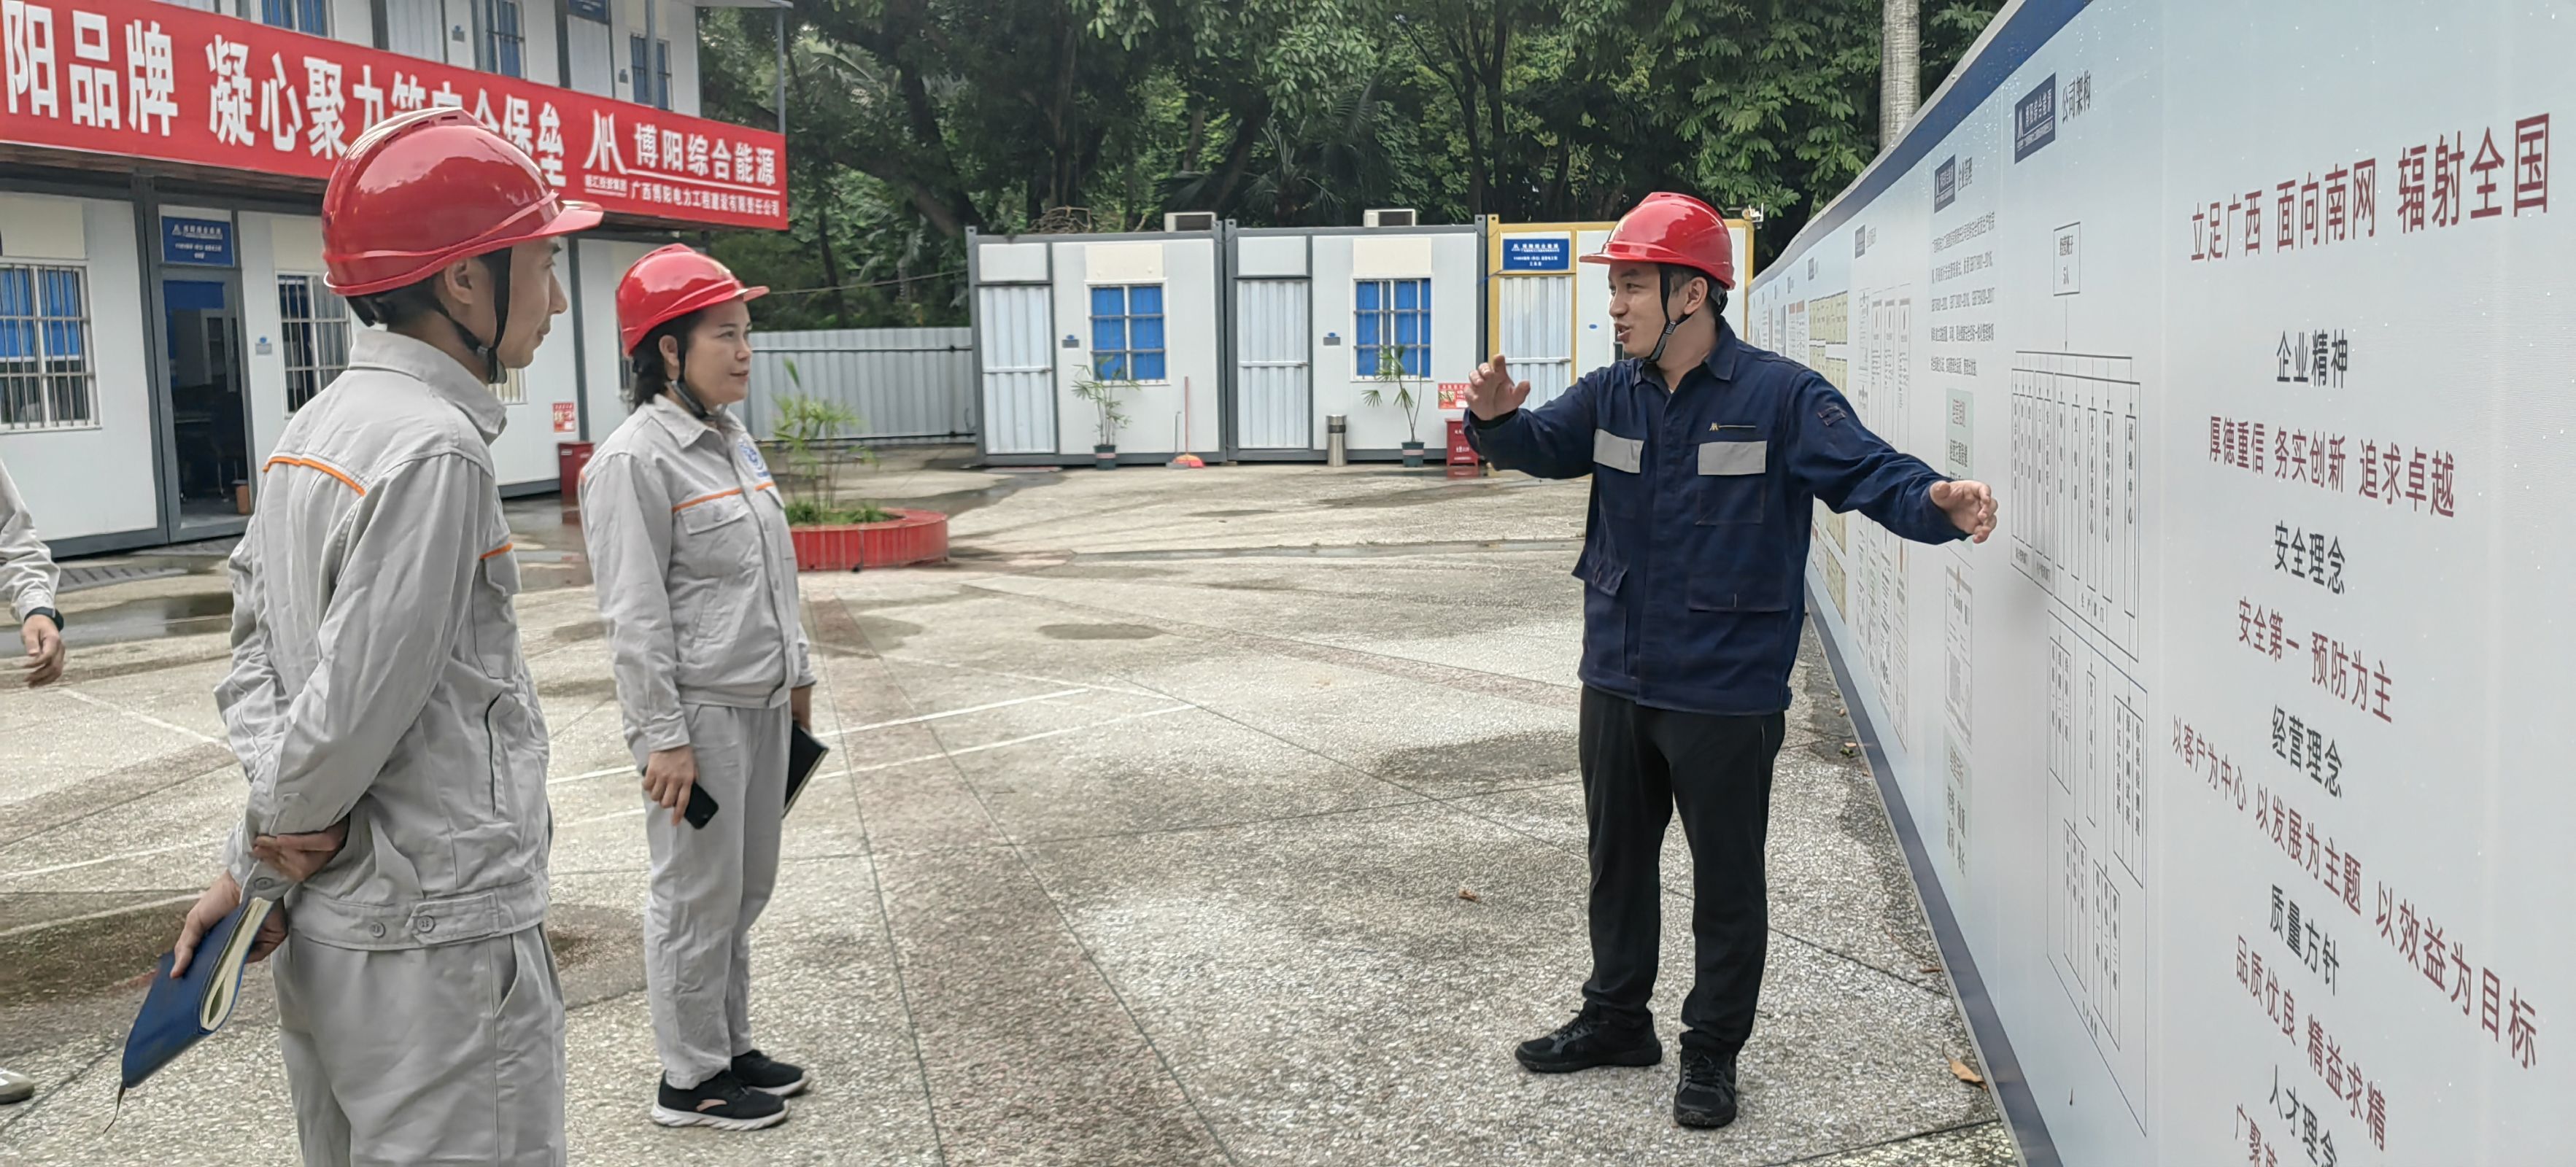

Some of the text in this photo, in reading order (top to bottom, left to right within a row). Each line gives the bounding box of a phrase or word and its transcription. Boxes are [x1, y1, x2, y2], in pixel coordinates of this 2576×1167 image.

[2, 0, 177, 136] 阳品牌
[2062, 70, 2091, 124] 公司架构
[632, 181, 779, 217] 广西博阳电力工程建设有限责任公司
[634, 123, 775, 186] 博阳综合能源
[2192, 113, 2549, 261] 立足广西 面向南网 辐射全国
[2277, 329, 2348, 388] 企业精神
[2210, 416, 2453, 517] 厚德重信 务实创新 追求卓越
[2275, 520, 2345, 594] 安全理念
[2239, 597, 2391, 723] 安全第一 预防为主
[2273, 705, 2342, 798] 经营理念
[2173, 716, 2246, 811] 以客户为中心
[2256, 784, 2361, 915] 以发展为主题
[2376, 881, 2536, 1069] 以效益为目标
[2270, 884, 2339, 996] 质量方针
[2237, 935, 2386, 1151] 品质优良 精益求精
[2270, 1065, 2337, 1167] 人才理念
